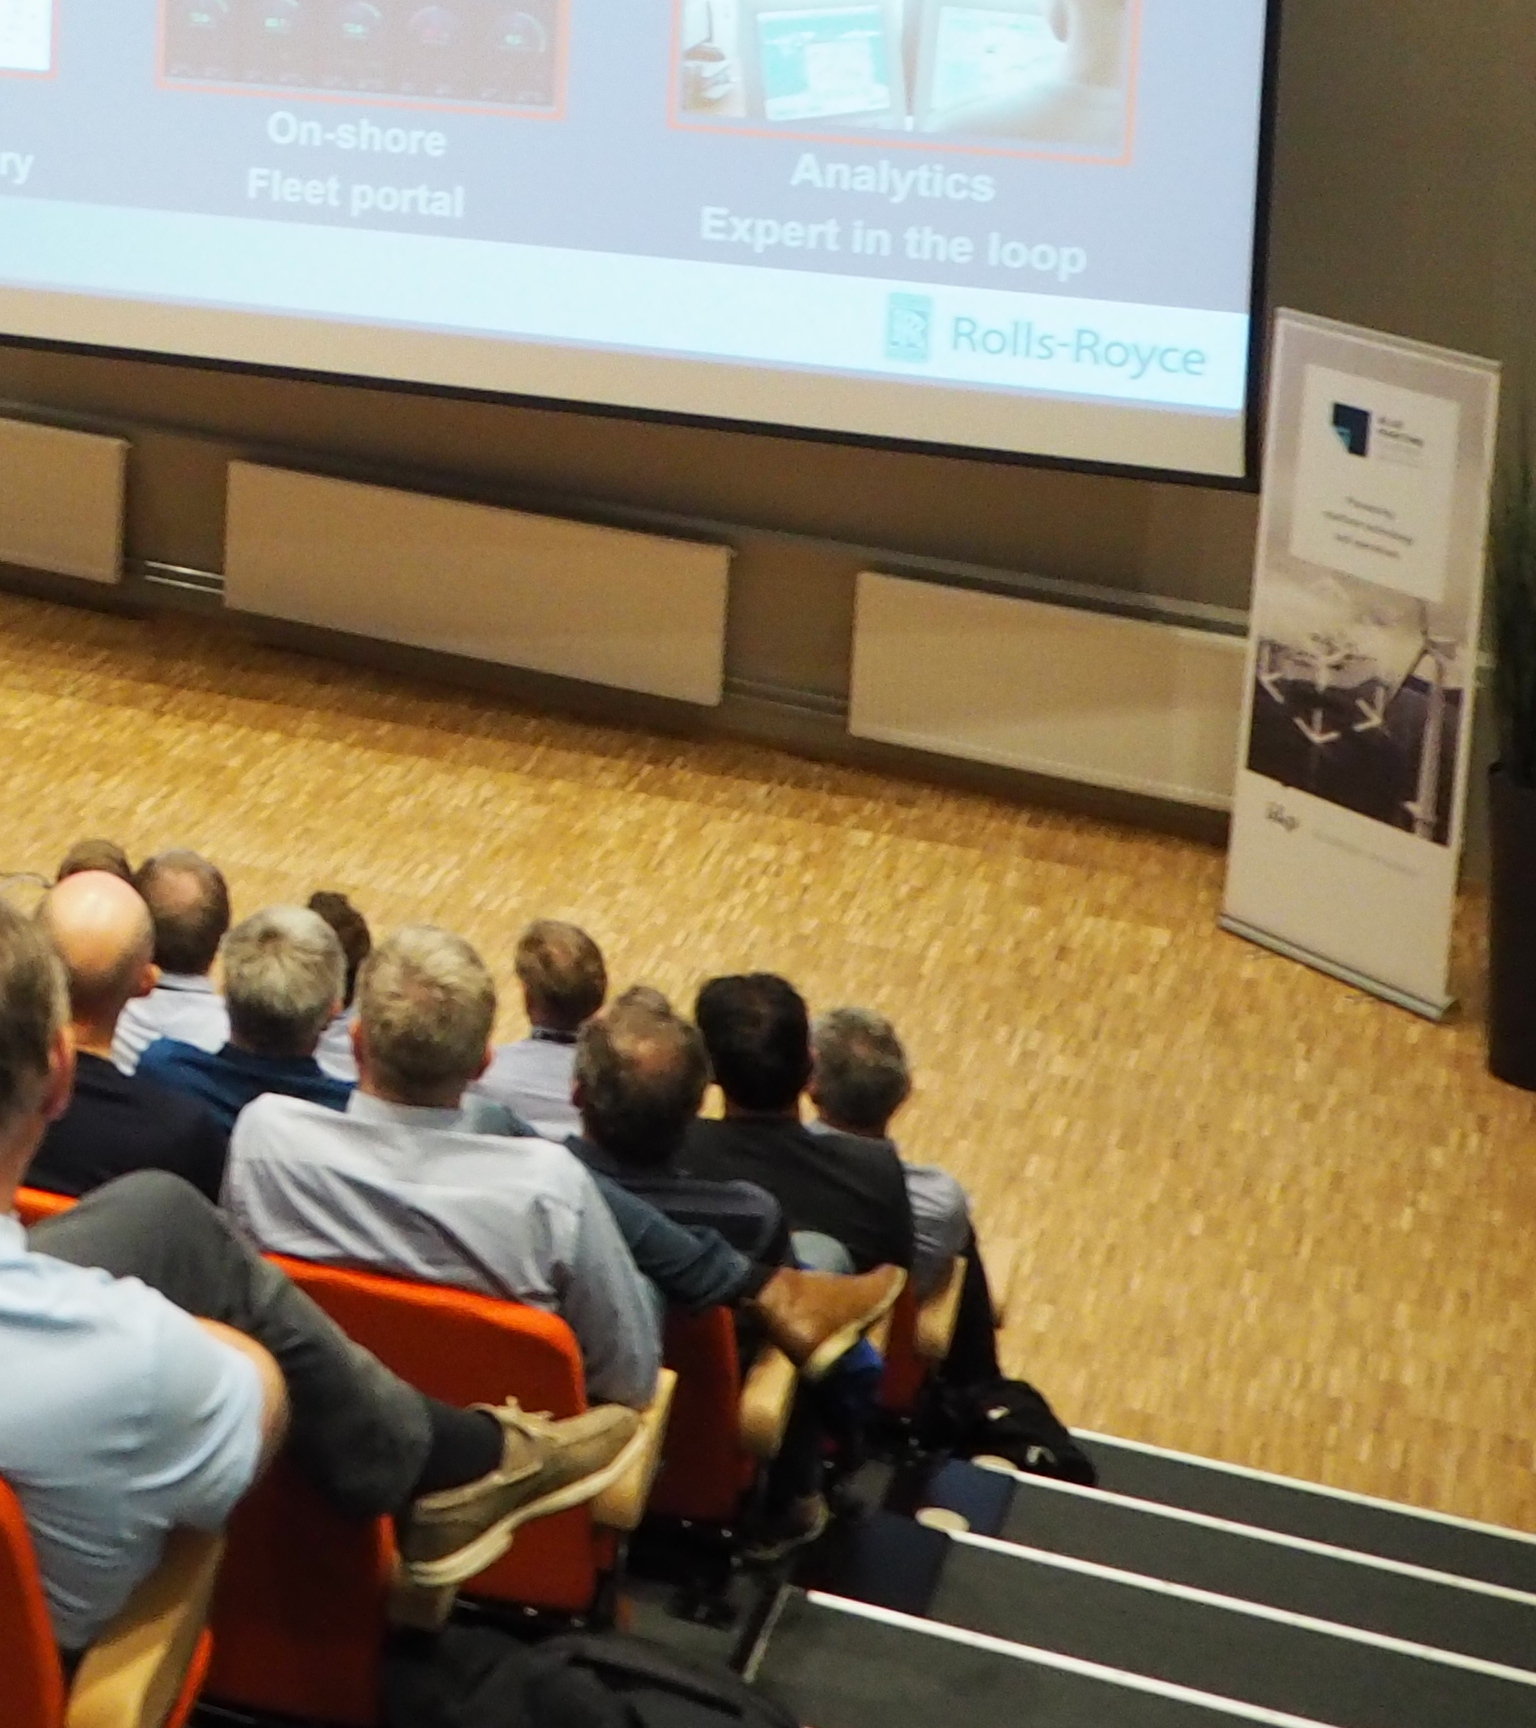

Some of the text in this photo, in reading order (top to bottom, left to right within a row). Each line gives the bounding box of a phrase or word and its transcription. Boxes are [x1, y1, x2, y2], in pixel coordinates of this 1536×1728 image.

[267, 110, 448, 157] On-shore
[246, 167, 466, 219] Fleet portal
[790, 152, 996, 204] Analytics
[699, 205, 1088, 282] Expert in the loop
[951, 316, 1206, 380] Rolls-Royce
